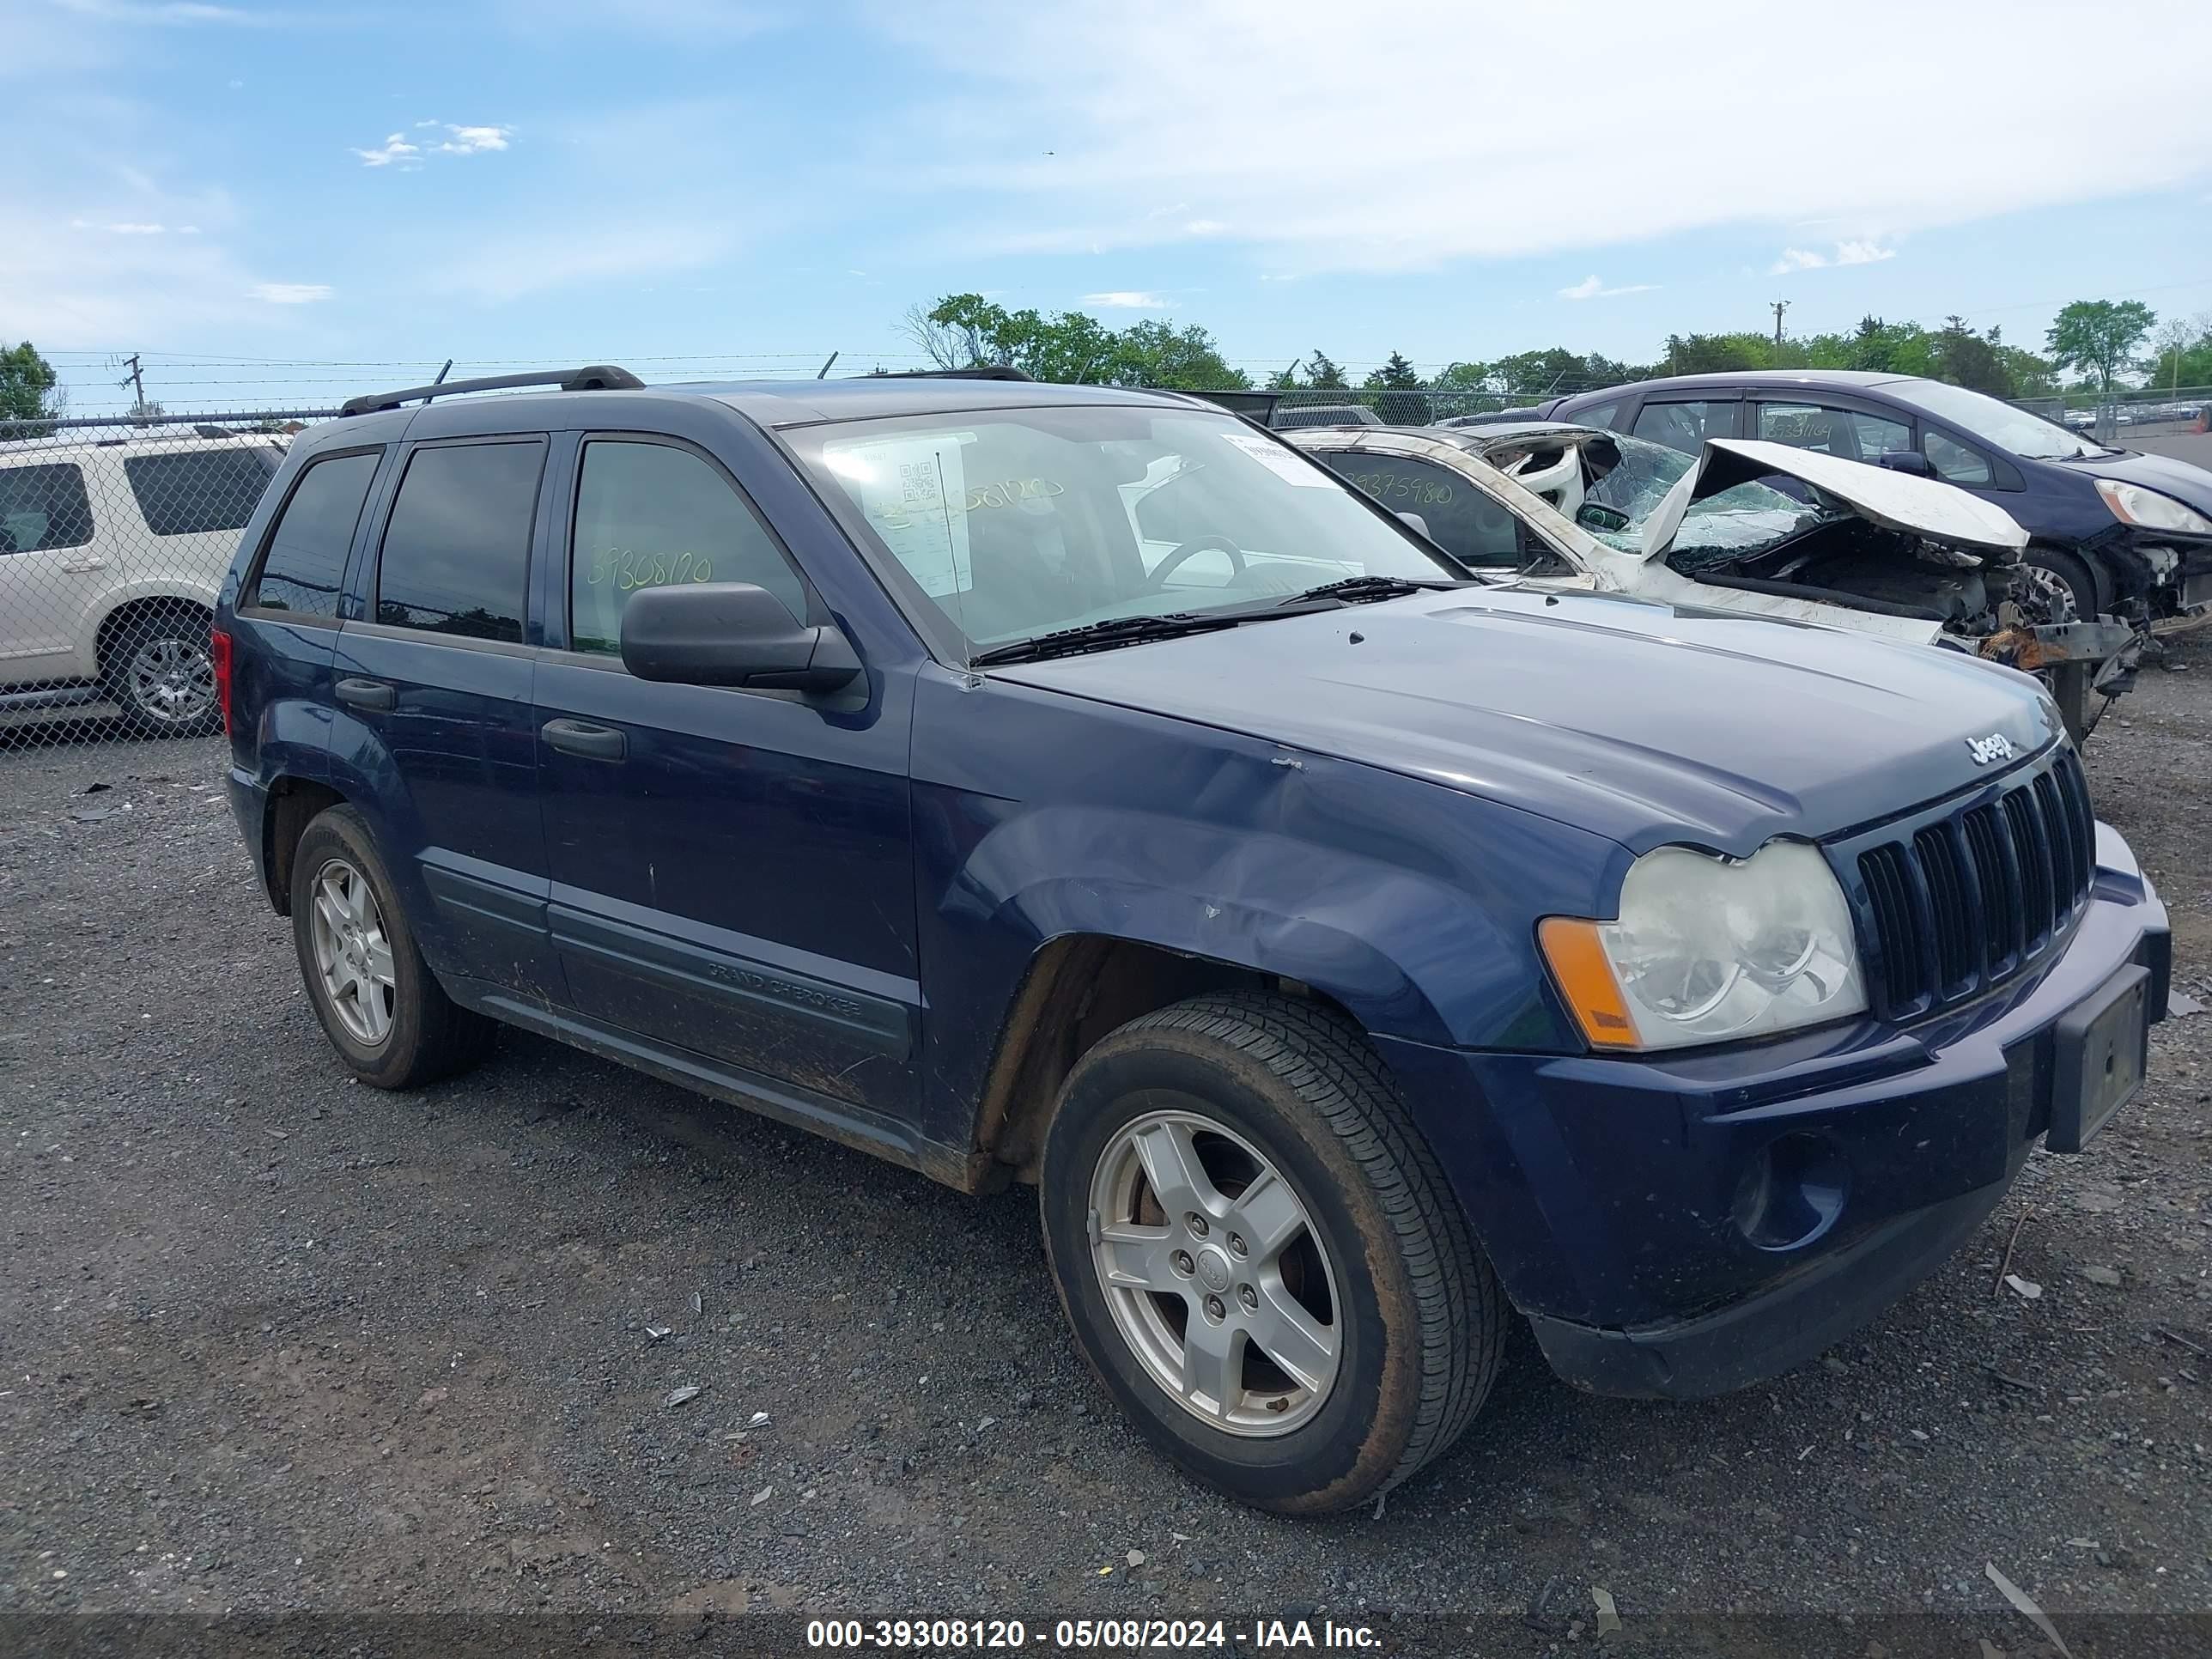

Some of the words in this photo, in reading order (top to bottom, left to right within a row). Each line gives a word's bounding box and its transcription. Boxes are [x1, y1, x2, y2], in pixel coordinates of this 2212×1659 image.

[586, 545, 713, 590] 39308120
[1965, 732, 2013, 765] Jeep
[707, 963, 765, 988] GRAND
[770, 980, 863, 1017] CHEROKEE
